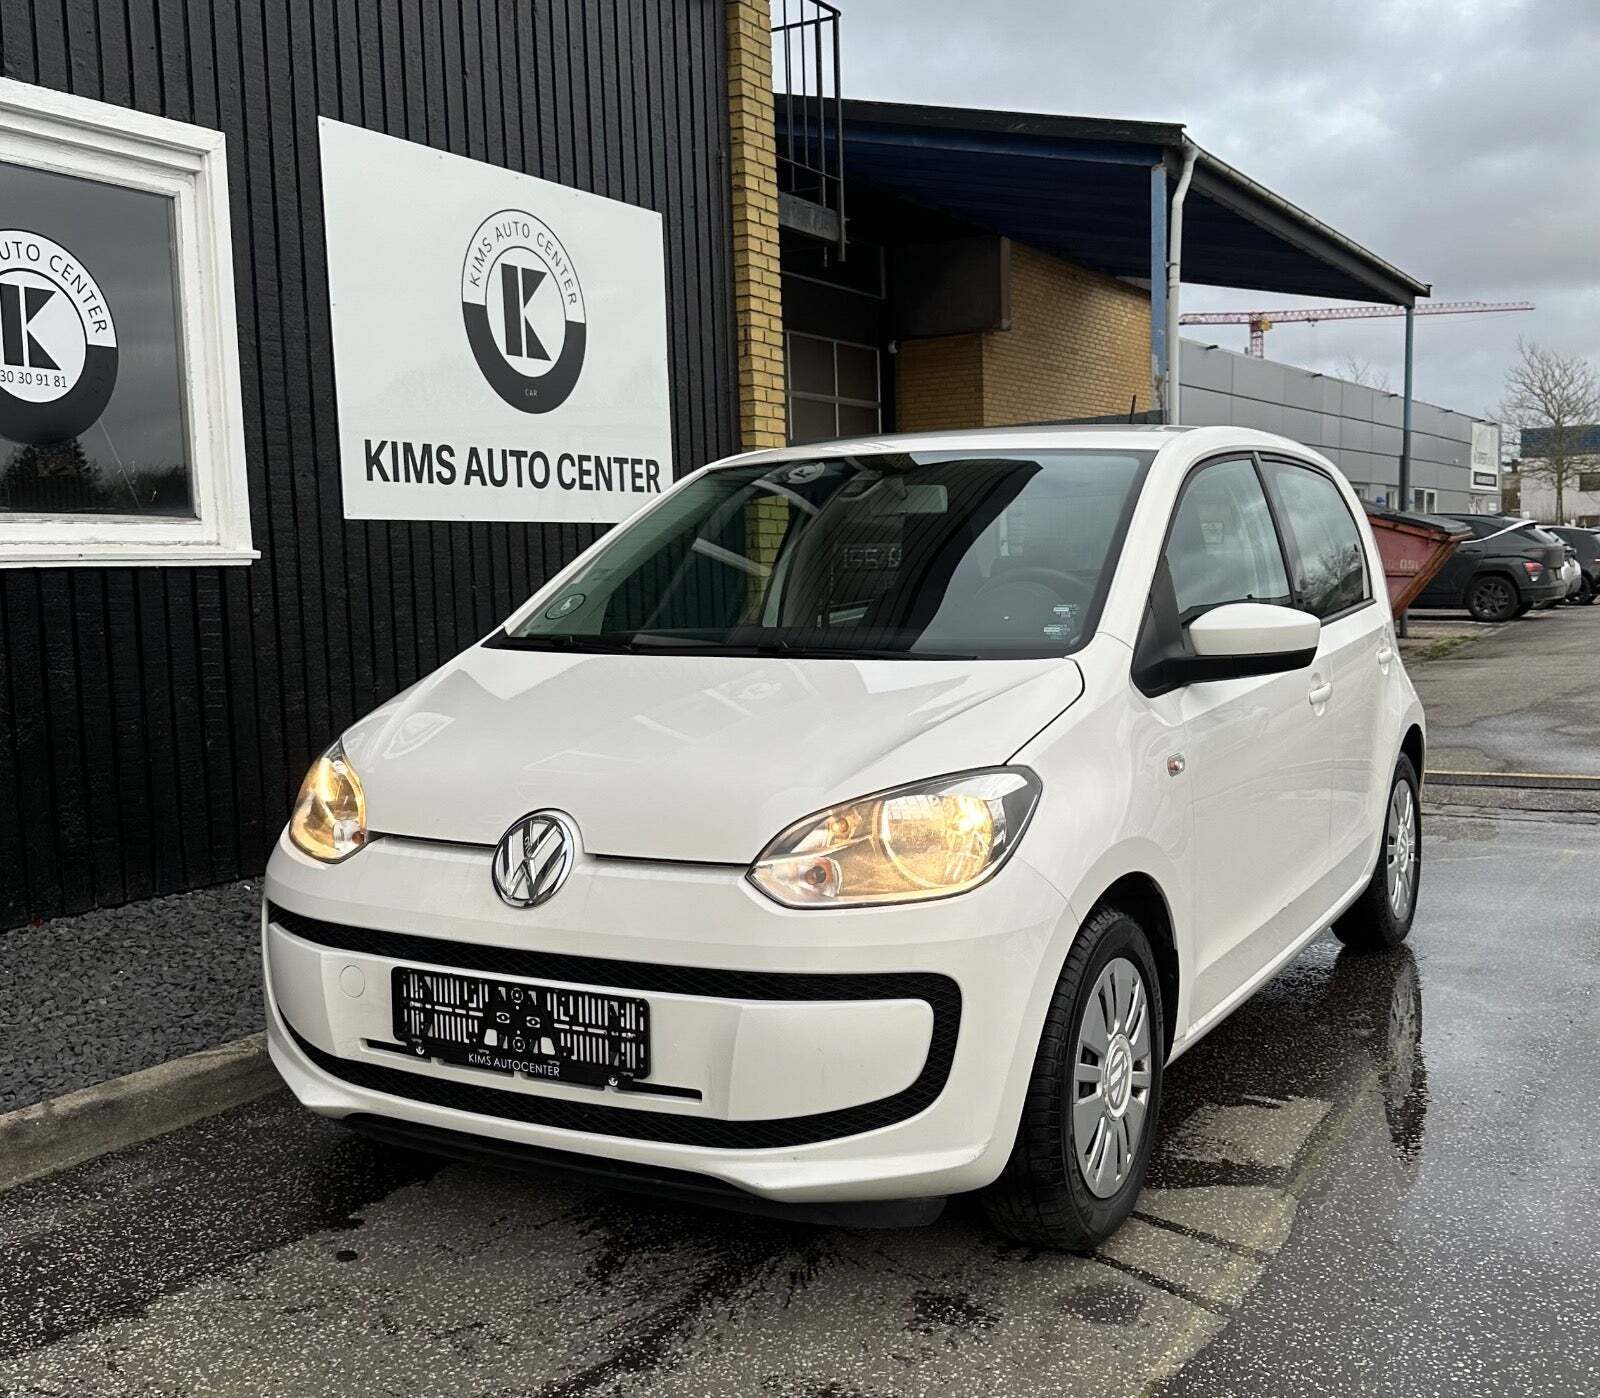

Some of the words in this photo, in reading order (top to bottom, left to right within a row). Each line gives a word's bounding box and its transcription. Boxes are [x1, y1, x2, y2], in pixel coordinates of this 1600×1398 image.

[469, 237, 493, 288] KIMS
[495, 220, 531, 243] AUTO
[536, 232, 577, 305] CENTER
[49, 254, 108, 334] CENTER
[17, 371, 33, 385] 30
[35, 373, 50, 387] 91
[53, 375, 67, 388] 81
[524, 388, 538, 397] CAR
[364, 439, 456, 485] KIMS
[464, 446, 551, 489] AUTO
[557, 453, 661, 493] CENTER
[468, 1053, 491, 1066] KIMS
[493, 1057, 560, 1077] AUTOCENTER
